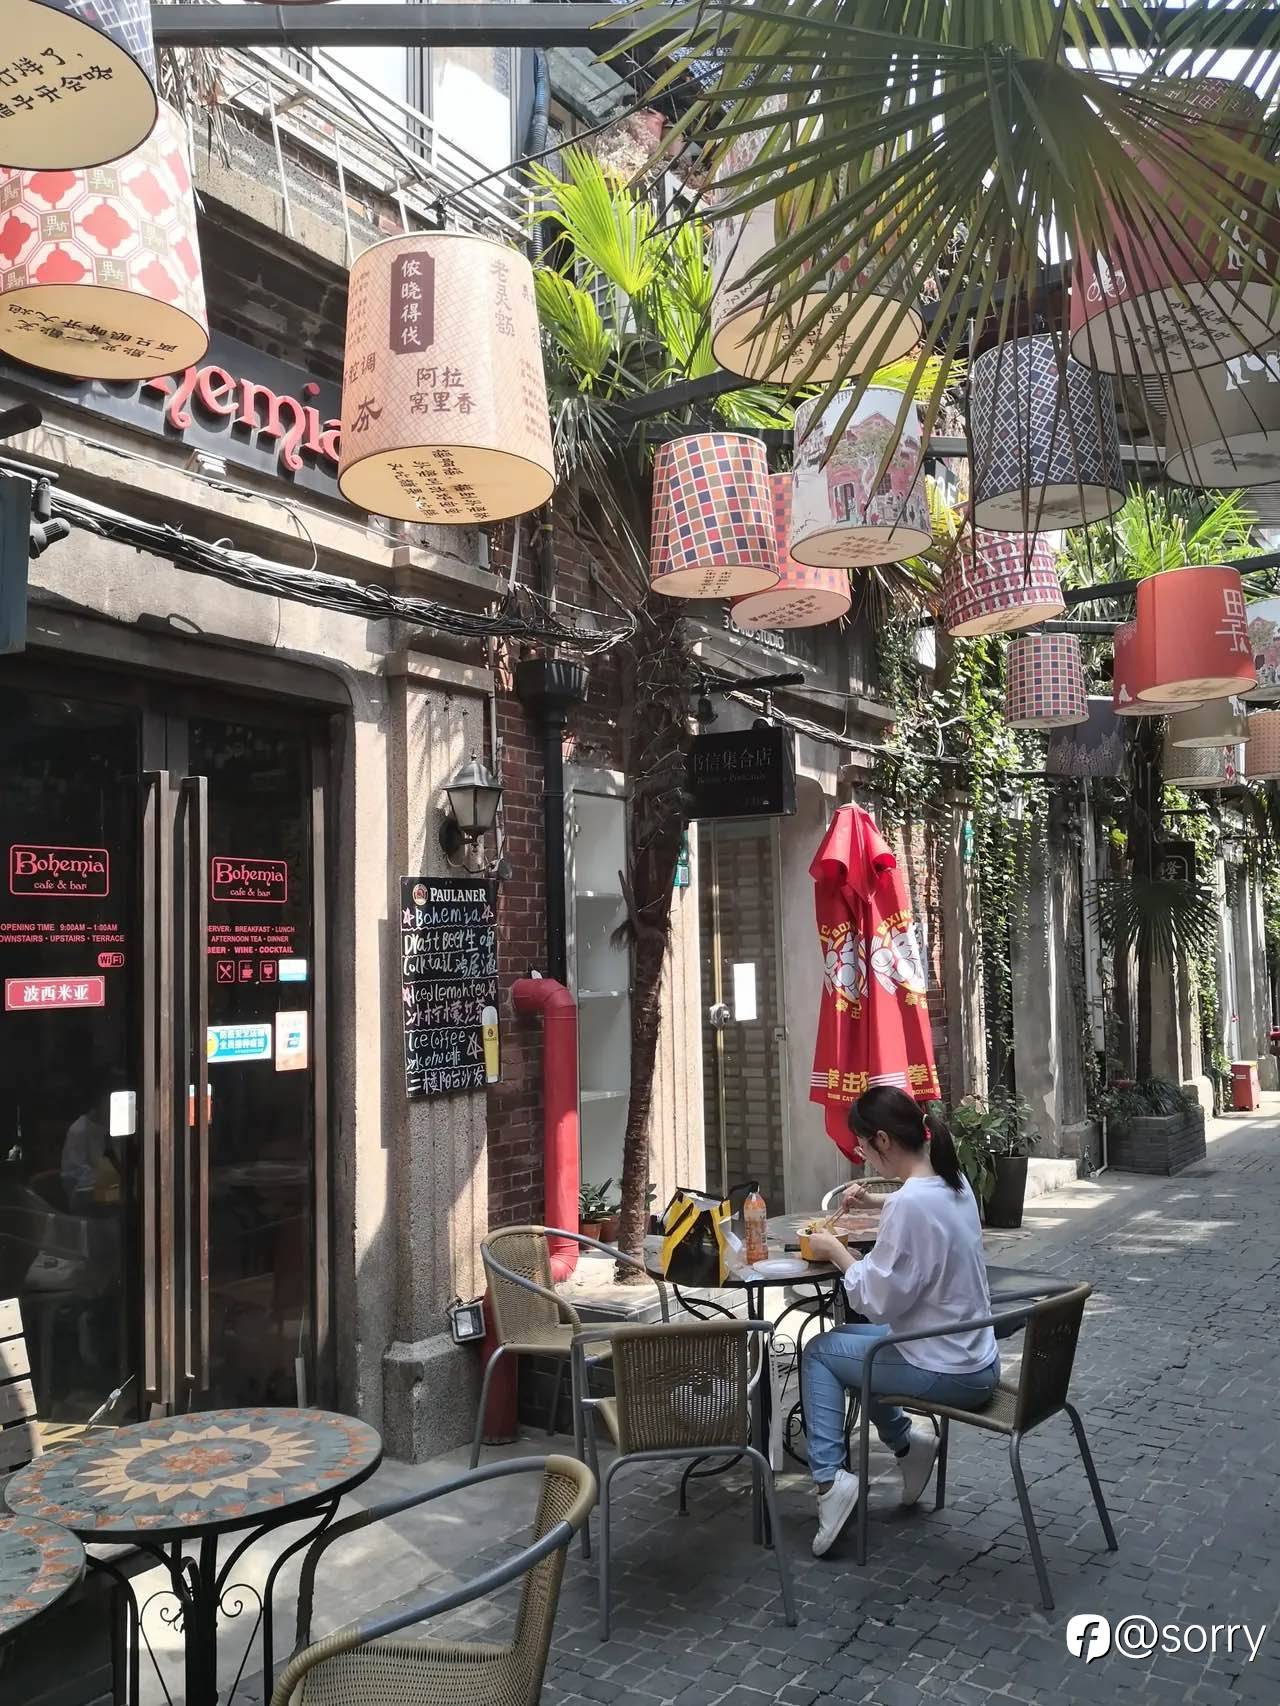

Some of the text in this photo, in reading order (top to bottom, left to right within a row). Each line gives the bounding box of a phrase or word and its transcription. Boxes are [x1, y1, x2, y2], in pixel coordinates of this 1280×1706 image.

[400, 258, 423, 346] 侬晓得伐
[416, 367, 465, 388] 阿拉
[15, 851, 104, 878] Bohemia
[215, 862, 284, 887] Bohemia
[34, 879, 87, 890] cafe & bar
[230, 887, 271, 897] cafe & bar
[430, 887, 487, 903] PAULANER
[415, 905, 481, 927] Bohemia
[0, 923, 36, 932] OPENING
[37, 923, 55, 932] TIME
[60, 923, 86, 932] 9:00AM
[235, 925, 271, 933] BREAKFAST
[50, 934, 86, 943] UPSTAIRS
[92, 934, 125, 943] TERRACE
[234, 946, 253, 954] WINE
[259, 946, 294, 954] COCKTAIL
[100, 954, 123, 966] WiFi
[23, 983, 89, 1003] 波西米亚
